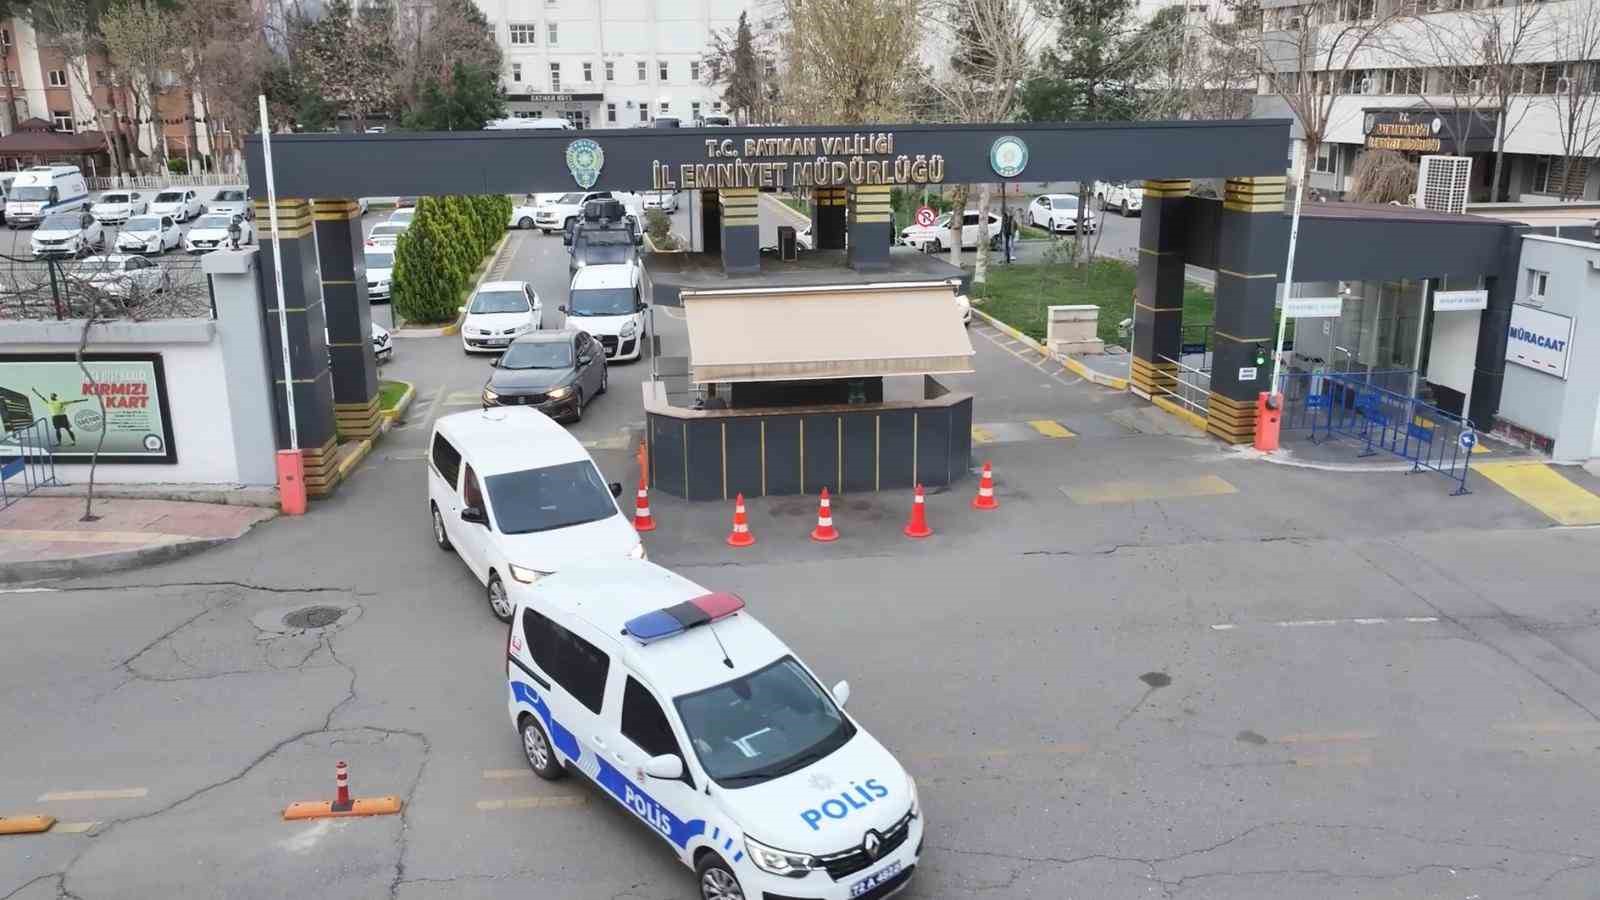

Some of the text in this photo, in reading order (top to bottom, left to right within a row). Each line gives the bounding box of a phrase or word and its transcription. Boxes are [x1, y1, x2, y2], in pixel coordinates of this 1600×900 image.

[705, 133, 894, 158] T.C. BATMAN VALİLİĞİ
[652, 155, 945, 190] İL EMNİYET MÜDÜRLÜĞÜ
[1509, 326, 1565, 352] MÜRACAAT
[82, 383, 148, 395] KIRMIZI
[106, 397, 149, 408] KART
[625, 784, 672, 836] POLİS
[801, 779, 889, 831] POLİS
